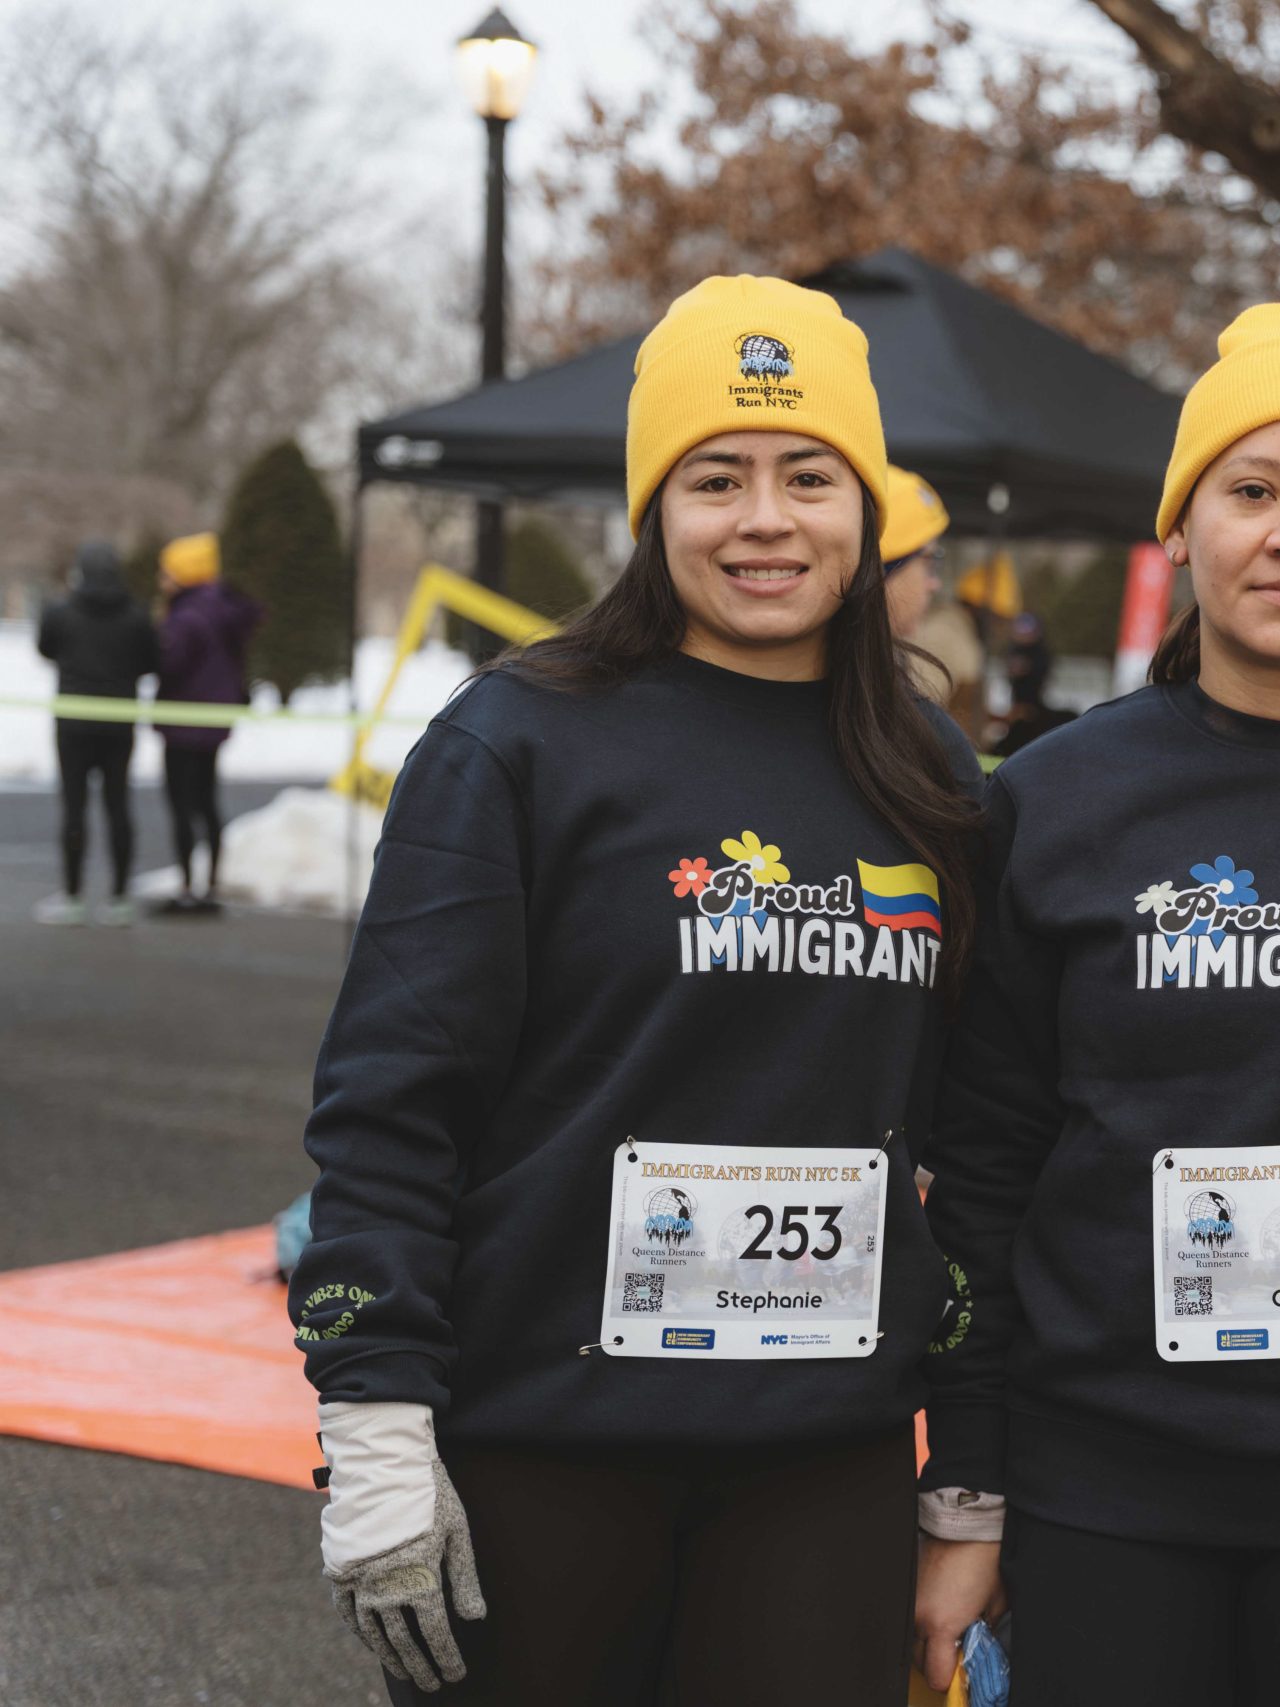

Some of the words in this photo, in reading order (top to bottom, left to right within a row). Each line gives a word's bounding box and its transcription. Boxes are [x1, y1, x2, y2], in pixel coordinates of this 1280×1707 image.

[728, 383, 804, 398] Immigrants
[736, 397, 762, 408] Run
[766, 397, 797, 410] NYC
[697, 860, 855, 917] Proud
[678, 914, 942, 989] IMMIGRANT
[641, 1162, 762, 1182] IMMIGRANTS
[765, 1167, 803, 1182] RUN
[805, 1167, 840, 1182] NYC
[841, 1168, 862, 1182] 5K
[738, 1204, 844, 1261] 253
[632, 1247, 666, 1257] Queens
[668, 1248, 706, 1257] Distance
[867, 1235, 875, 1252] 253
[650, 1257, 687, 1265] Runners
[1177, 1250, 1210, 1261] Queens
[1212, 1250, 1249, 1258] Distance
[1196, 1259, 1232, 1268] Runners
[305, 1283, 345, 1308] VIBES
[716, 1290, 823, 1313] Stephanie
[946, 1311, 972, 1349] GOOD
[761, 1334, 788, 1345] NYC
